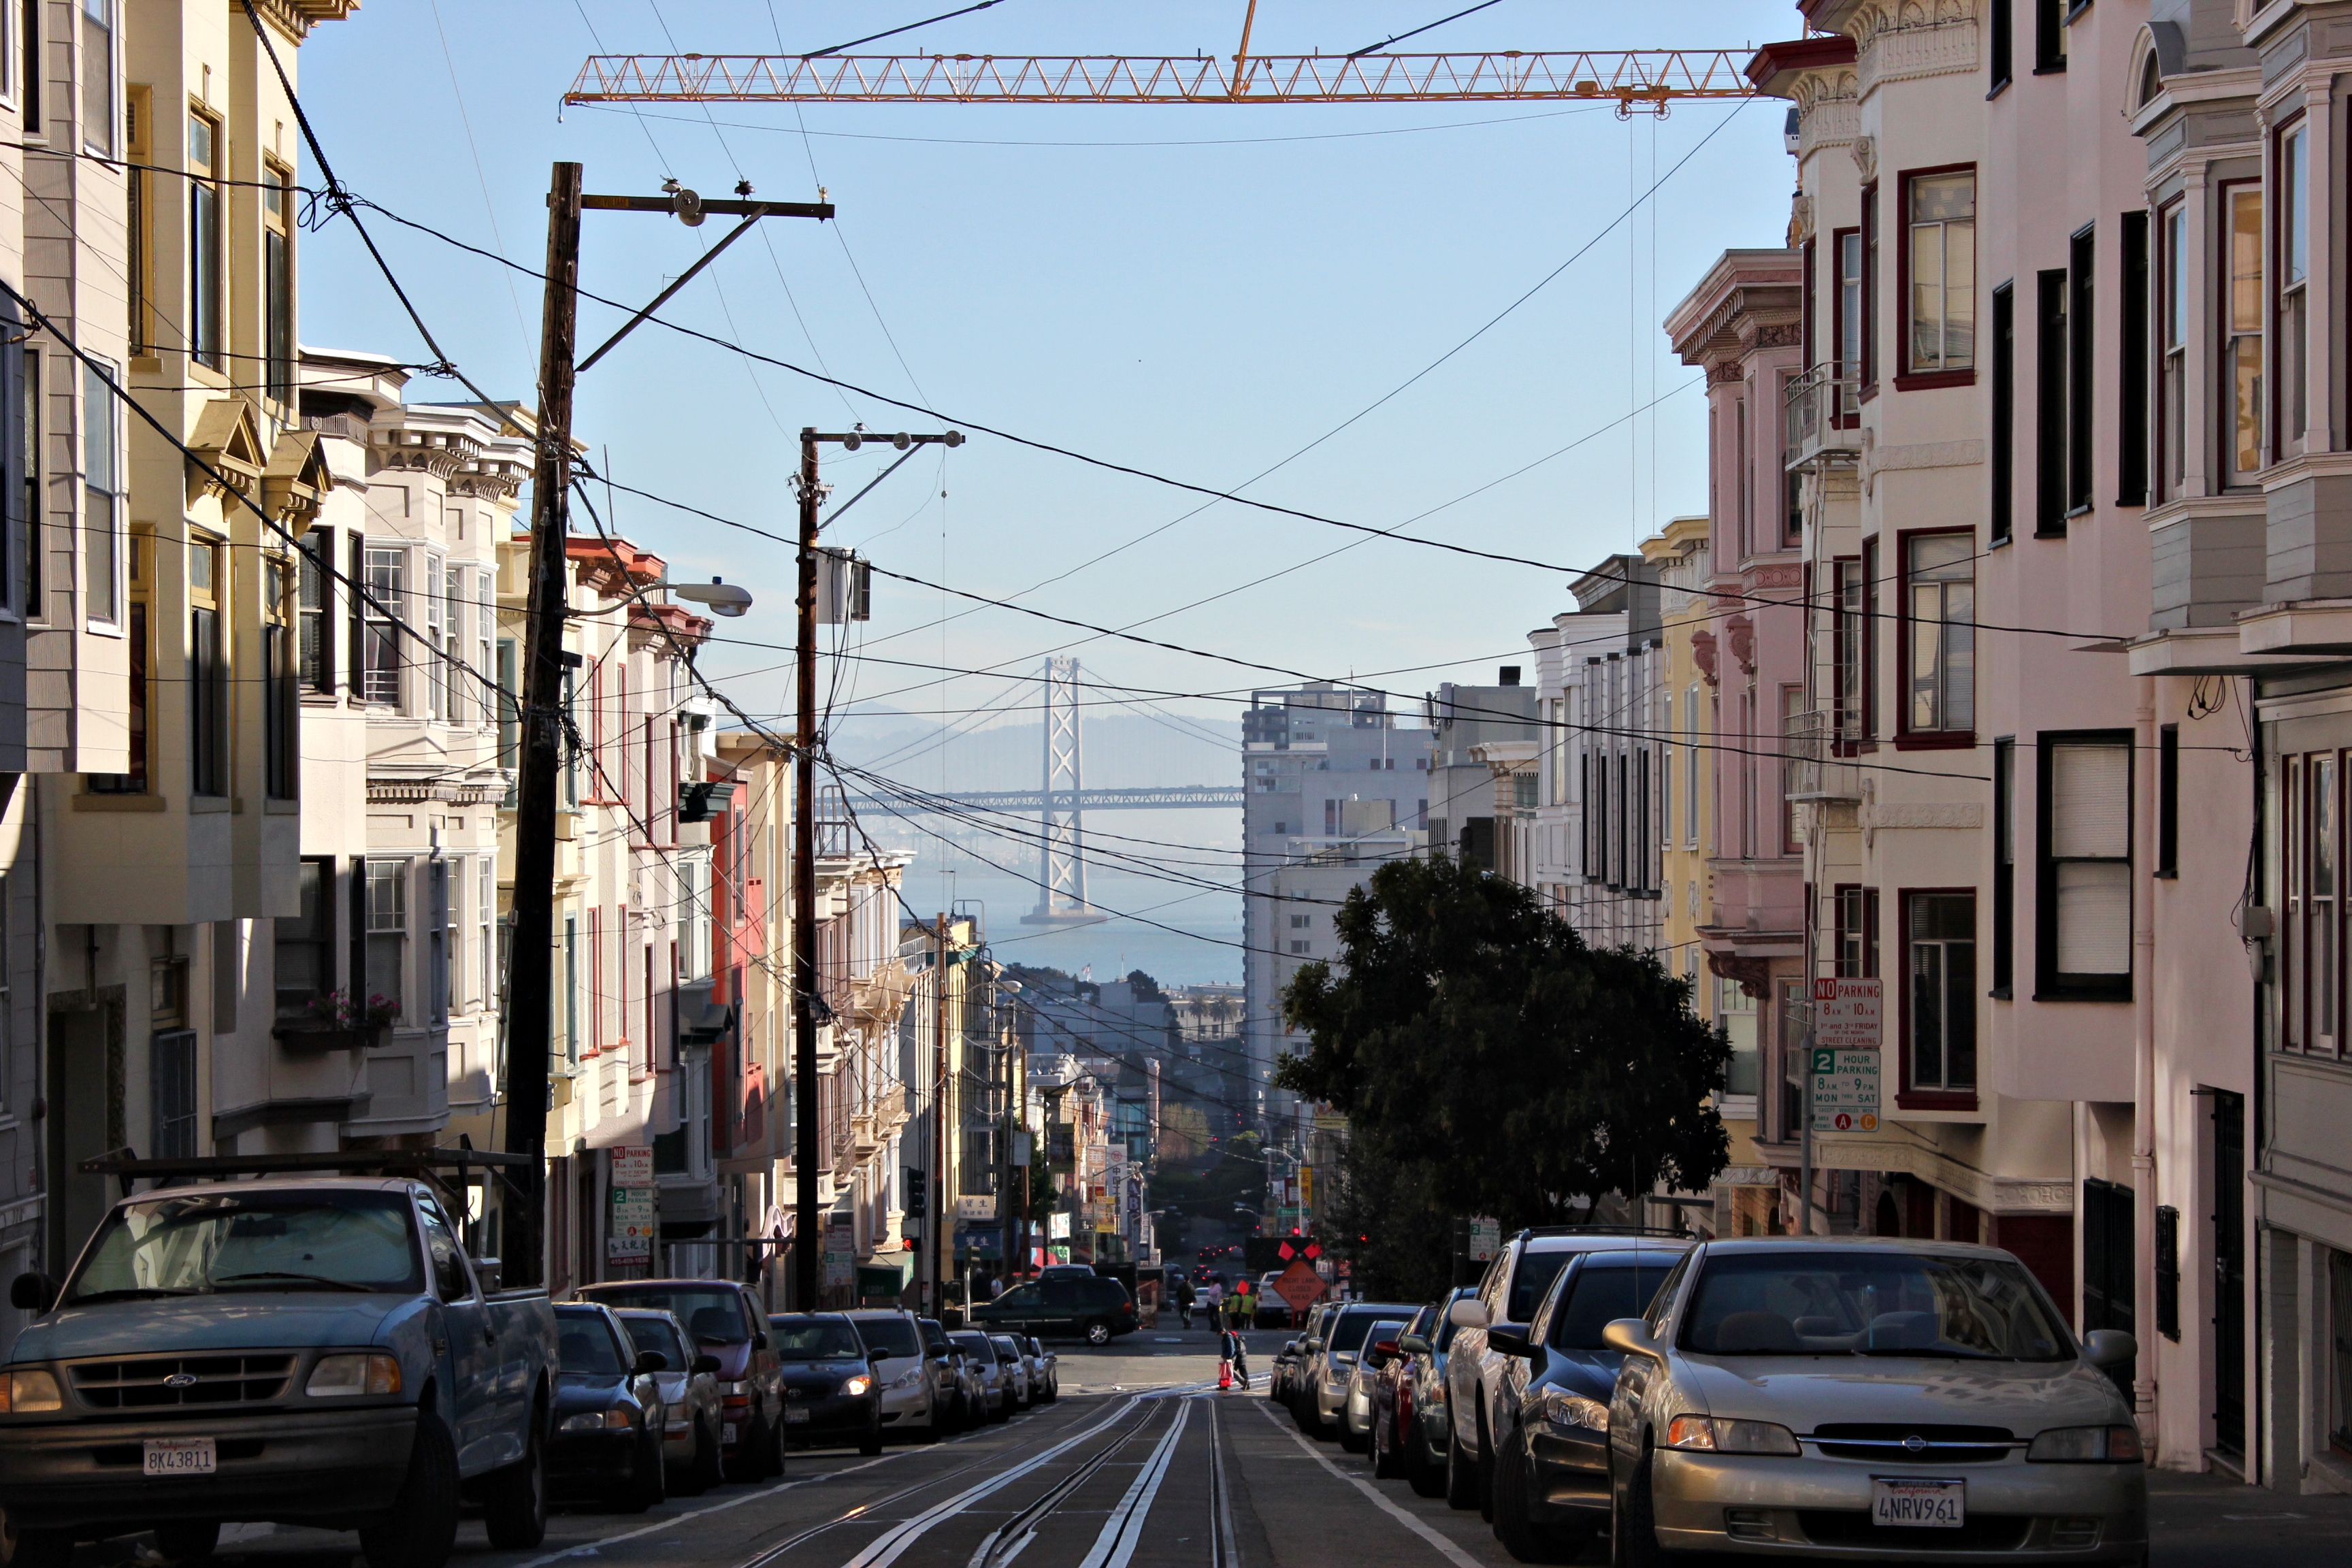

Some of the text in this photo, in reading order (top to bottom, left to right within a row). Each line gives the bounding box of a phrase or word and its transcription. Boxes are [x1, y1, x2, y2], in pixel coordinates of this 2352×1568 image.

[588, 197, 627, 207] HIGH VOLTAGE
[1817, 981, 1879, 998] NO PARKING
[1817, 1054, 1831, 1071] 2
[1844, 1055, 1870, 1064] HOUR
[1837, 1066, 1878, 1075] PARKING
[1816, 1094, 1838, 1102] MON
[1858, 1094, 1876, 1102] SAT
[1839, 1115, 1847, 1128] A
[1865, 1115, 1872, 1128] C
[614, 1148, 624, 1158] NO
[616, 1192, 624, 1201] 2
[159, 1442, 199, 1451] California
[149, 1450, 211, 1469] 8K43811
[1893, 1487, 1946, 1497] California
[1880, 1497, 1957, 1520] 4NRV961
